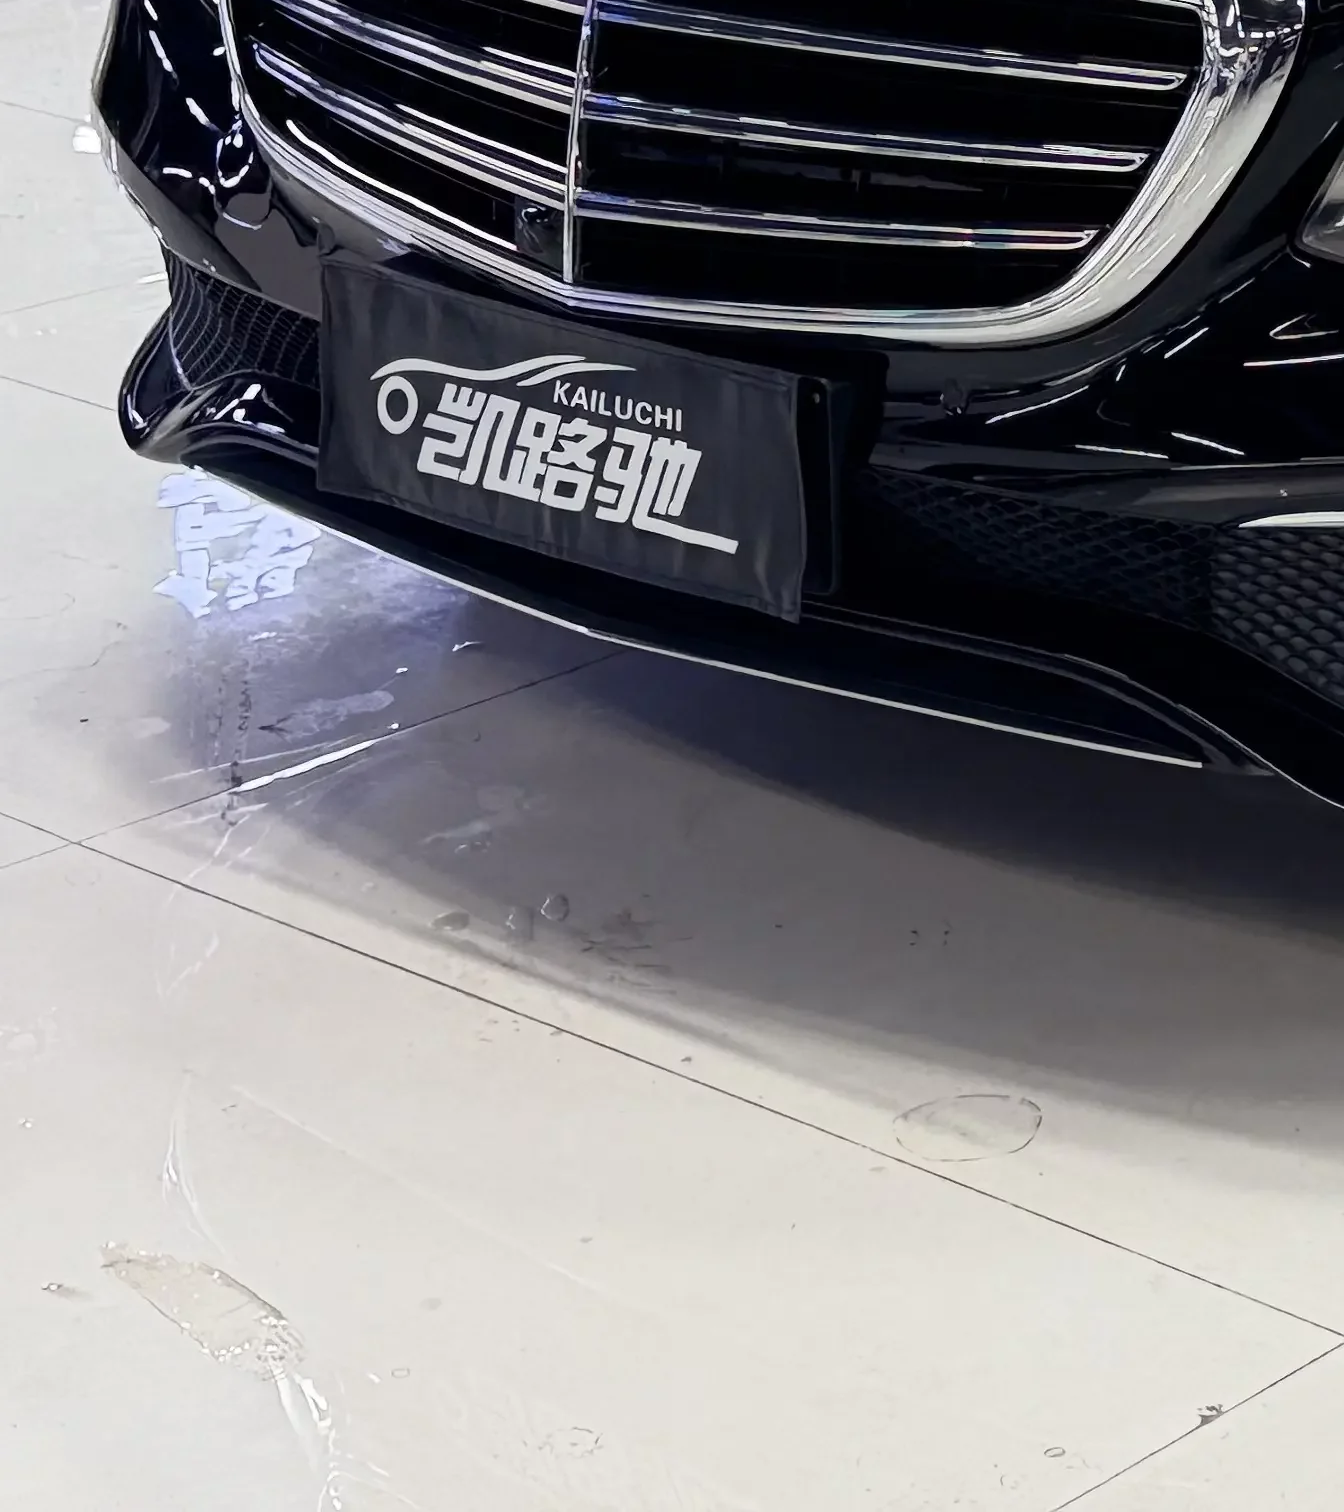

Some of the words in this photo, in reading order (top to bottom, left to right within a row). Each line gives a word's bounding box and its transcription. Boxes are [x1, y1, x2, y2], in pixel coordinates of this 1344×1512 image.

[554, 380, 683, 432] KAILUCHI
[416, 382, 739, 554] 凯路驰
